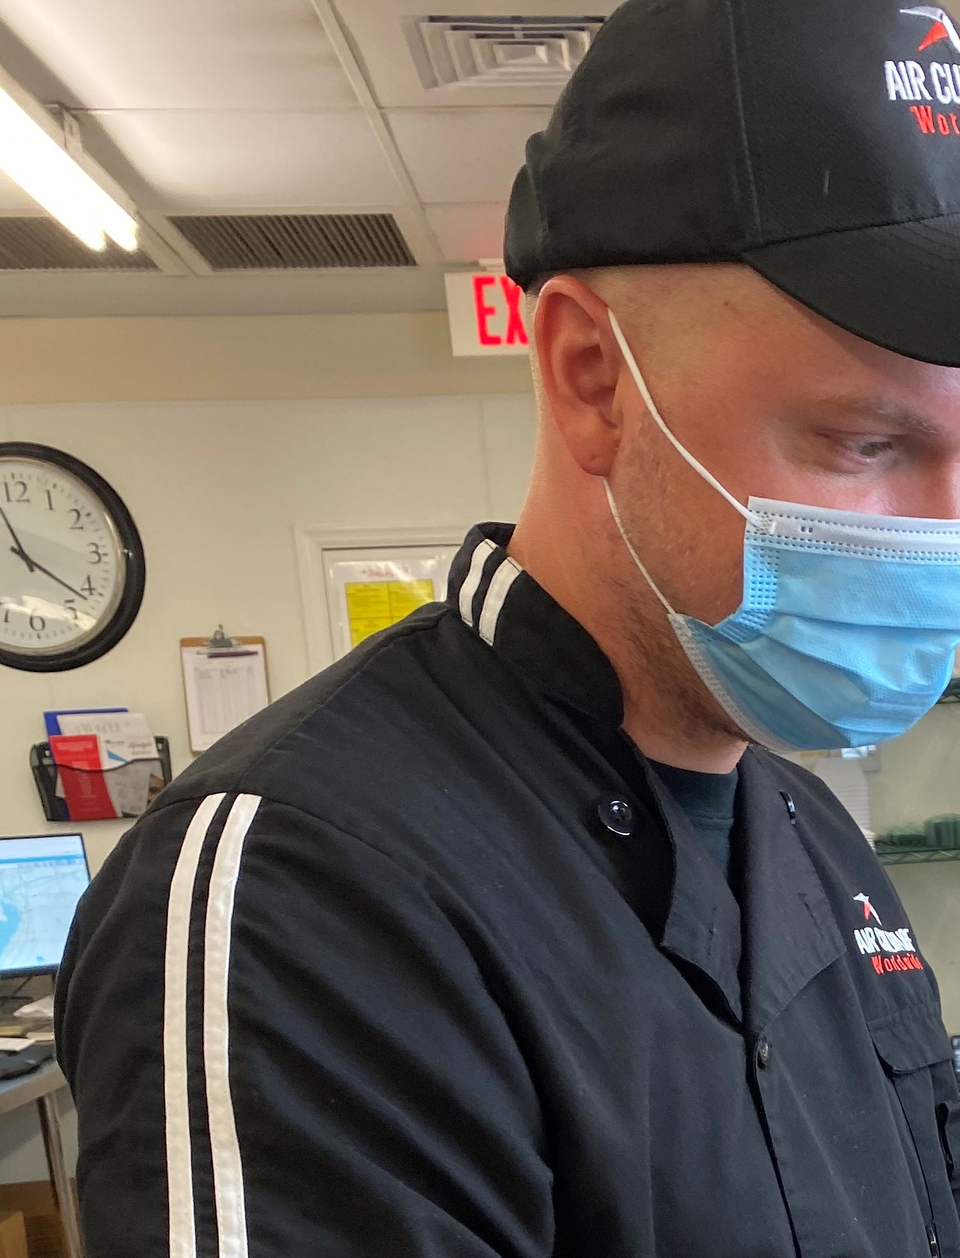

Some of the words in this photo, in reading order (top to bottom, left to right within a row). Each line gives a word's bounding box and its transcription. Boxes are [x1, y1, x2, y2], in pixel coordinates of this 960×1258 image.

[884, 60, 933, 101] AIR
[473, 275, 530, 345] EX
[2, 480, 31, 503] 12
[45, 489, 55, 511] 1
[67, 508, 84, 530] 2
[85, 541, 102, 564] 3
[80, 574, 96, 596] 4
[29, 609, 46, 631] 6
[854, 927, 881, 955] AIR
